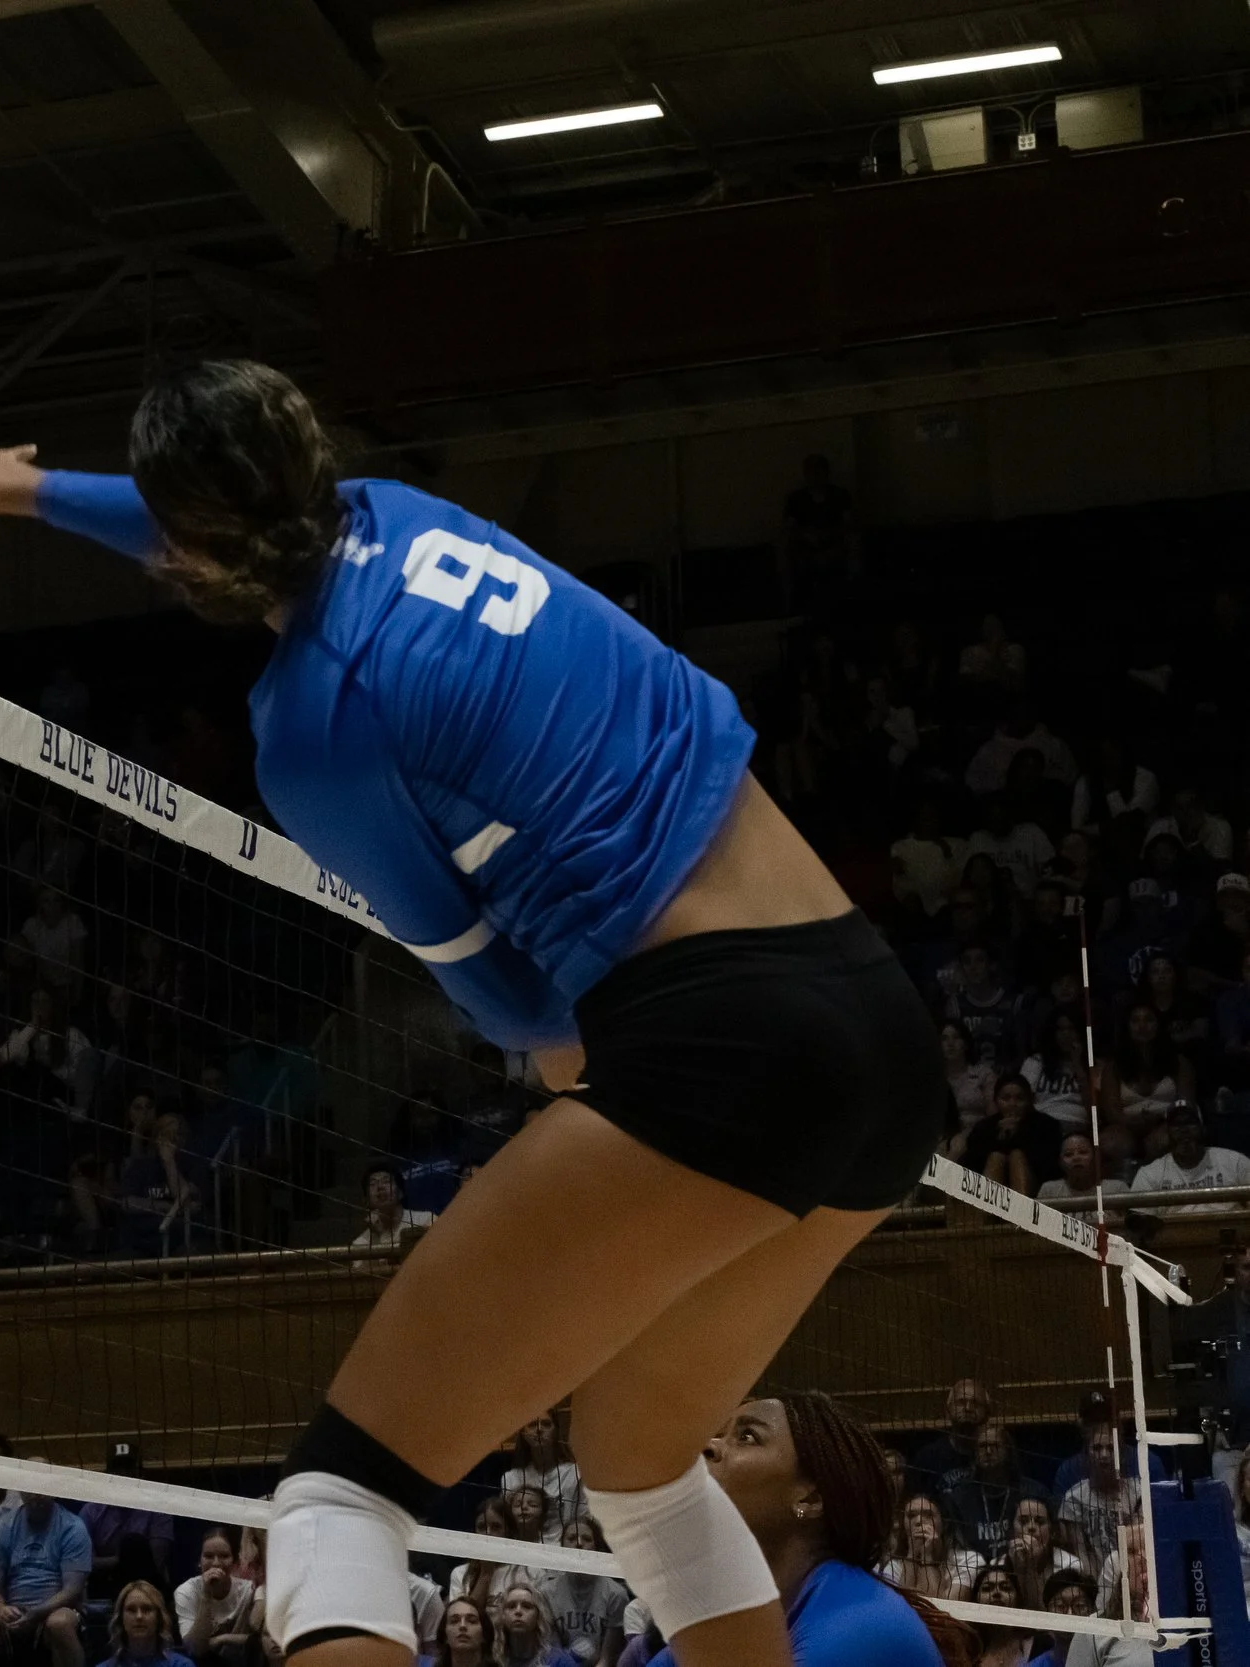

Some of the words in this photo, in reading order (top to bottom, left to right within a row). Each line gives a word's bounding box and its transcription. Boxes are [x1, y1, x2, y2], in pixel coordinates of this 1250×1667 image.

[401, 527, 552, 637] 9
[39, 718, 96, 785] BLUE
[105, 750, 178, 823] DEVILS
[114, 1442, 130, 1456] D
[1190, 1560, 1207, 1612] sports
